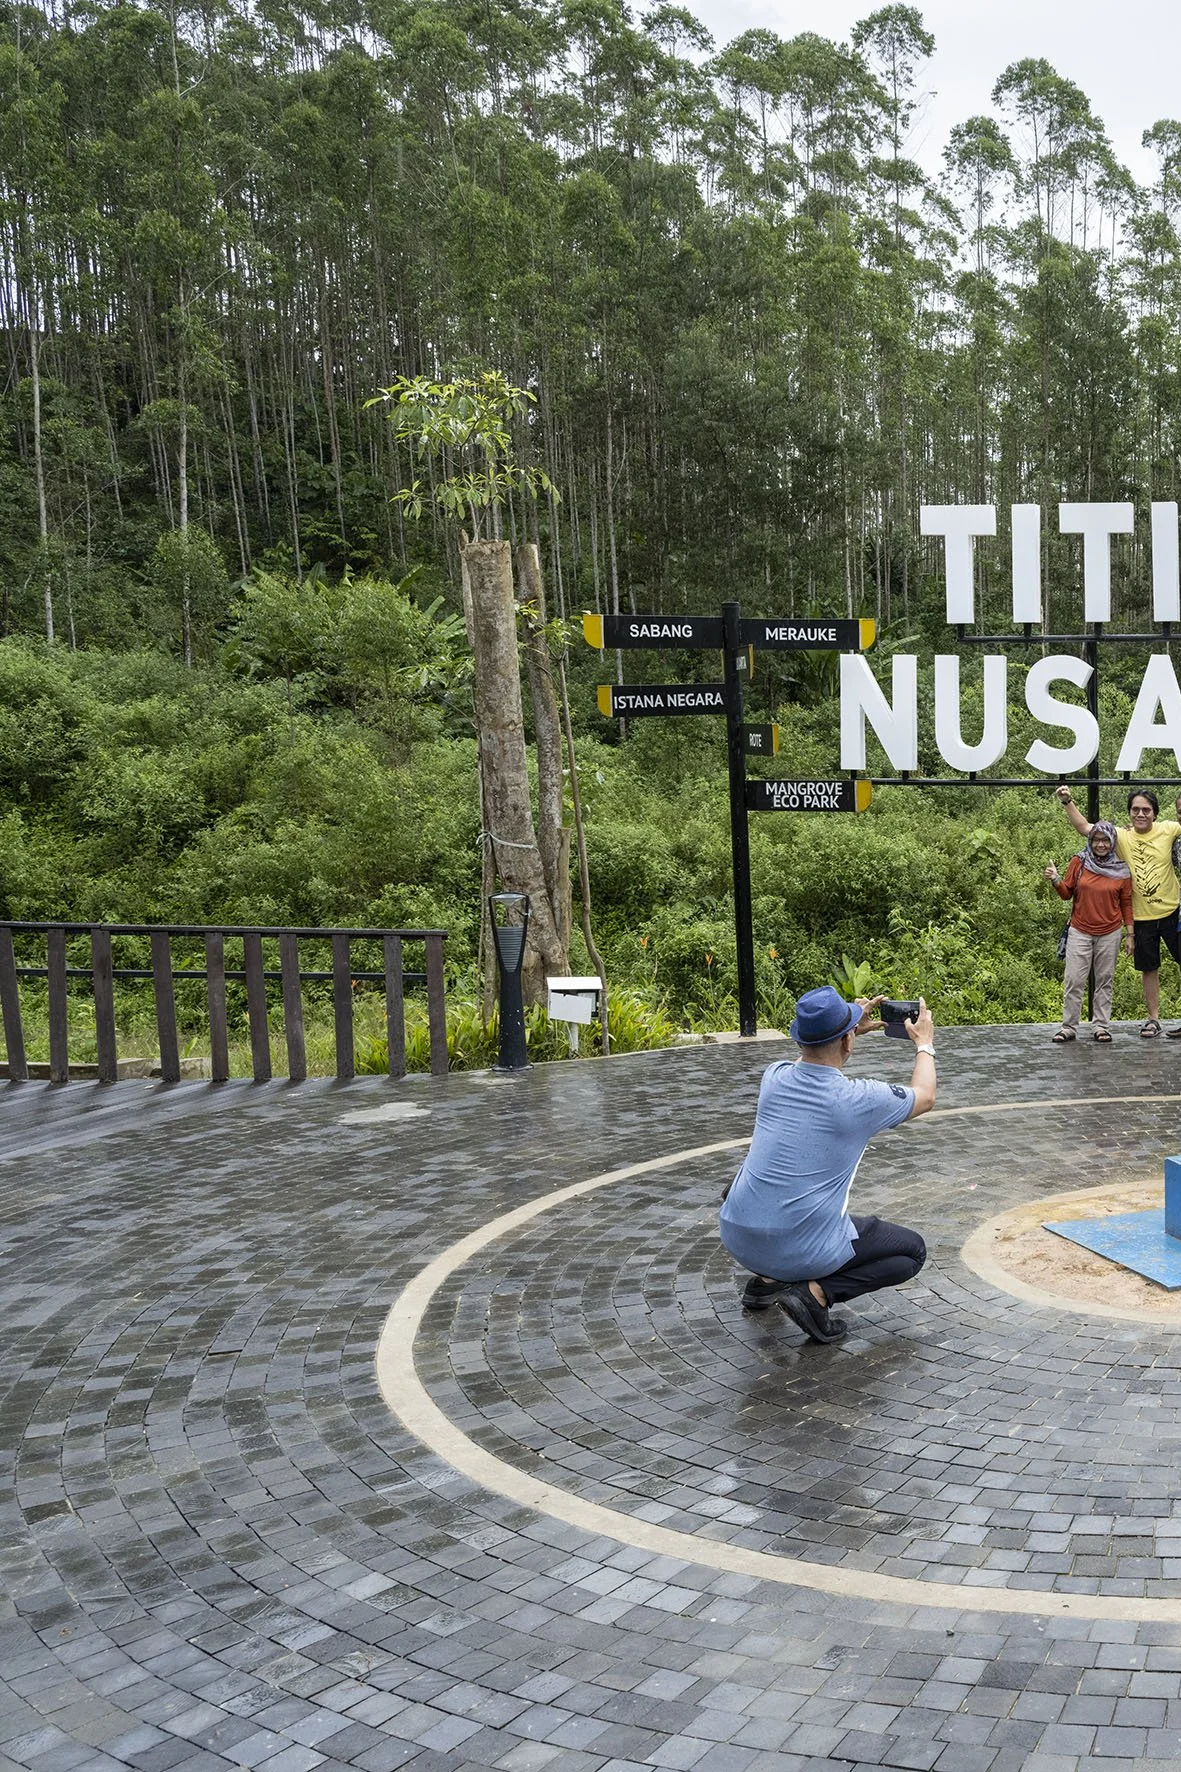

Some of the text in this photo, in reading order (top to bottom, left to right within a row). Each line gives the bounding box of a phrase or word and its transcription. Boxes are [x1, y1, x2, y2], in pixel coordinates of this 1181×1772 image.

[629, 624, 693, 638] SABANG
[765, 627, 837, 642] MERAUKE
[613, 692, 724, 709] ISTANA NEGARA
[765, 782, 843, 796] MANGROVE
[773, 795, 840, 809] ECO PARK
